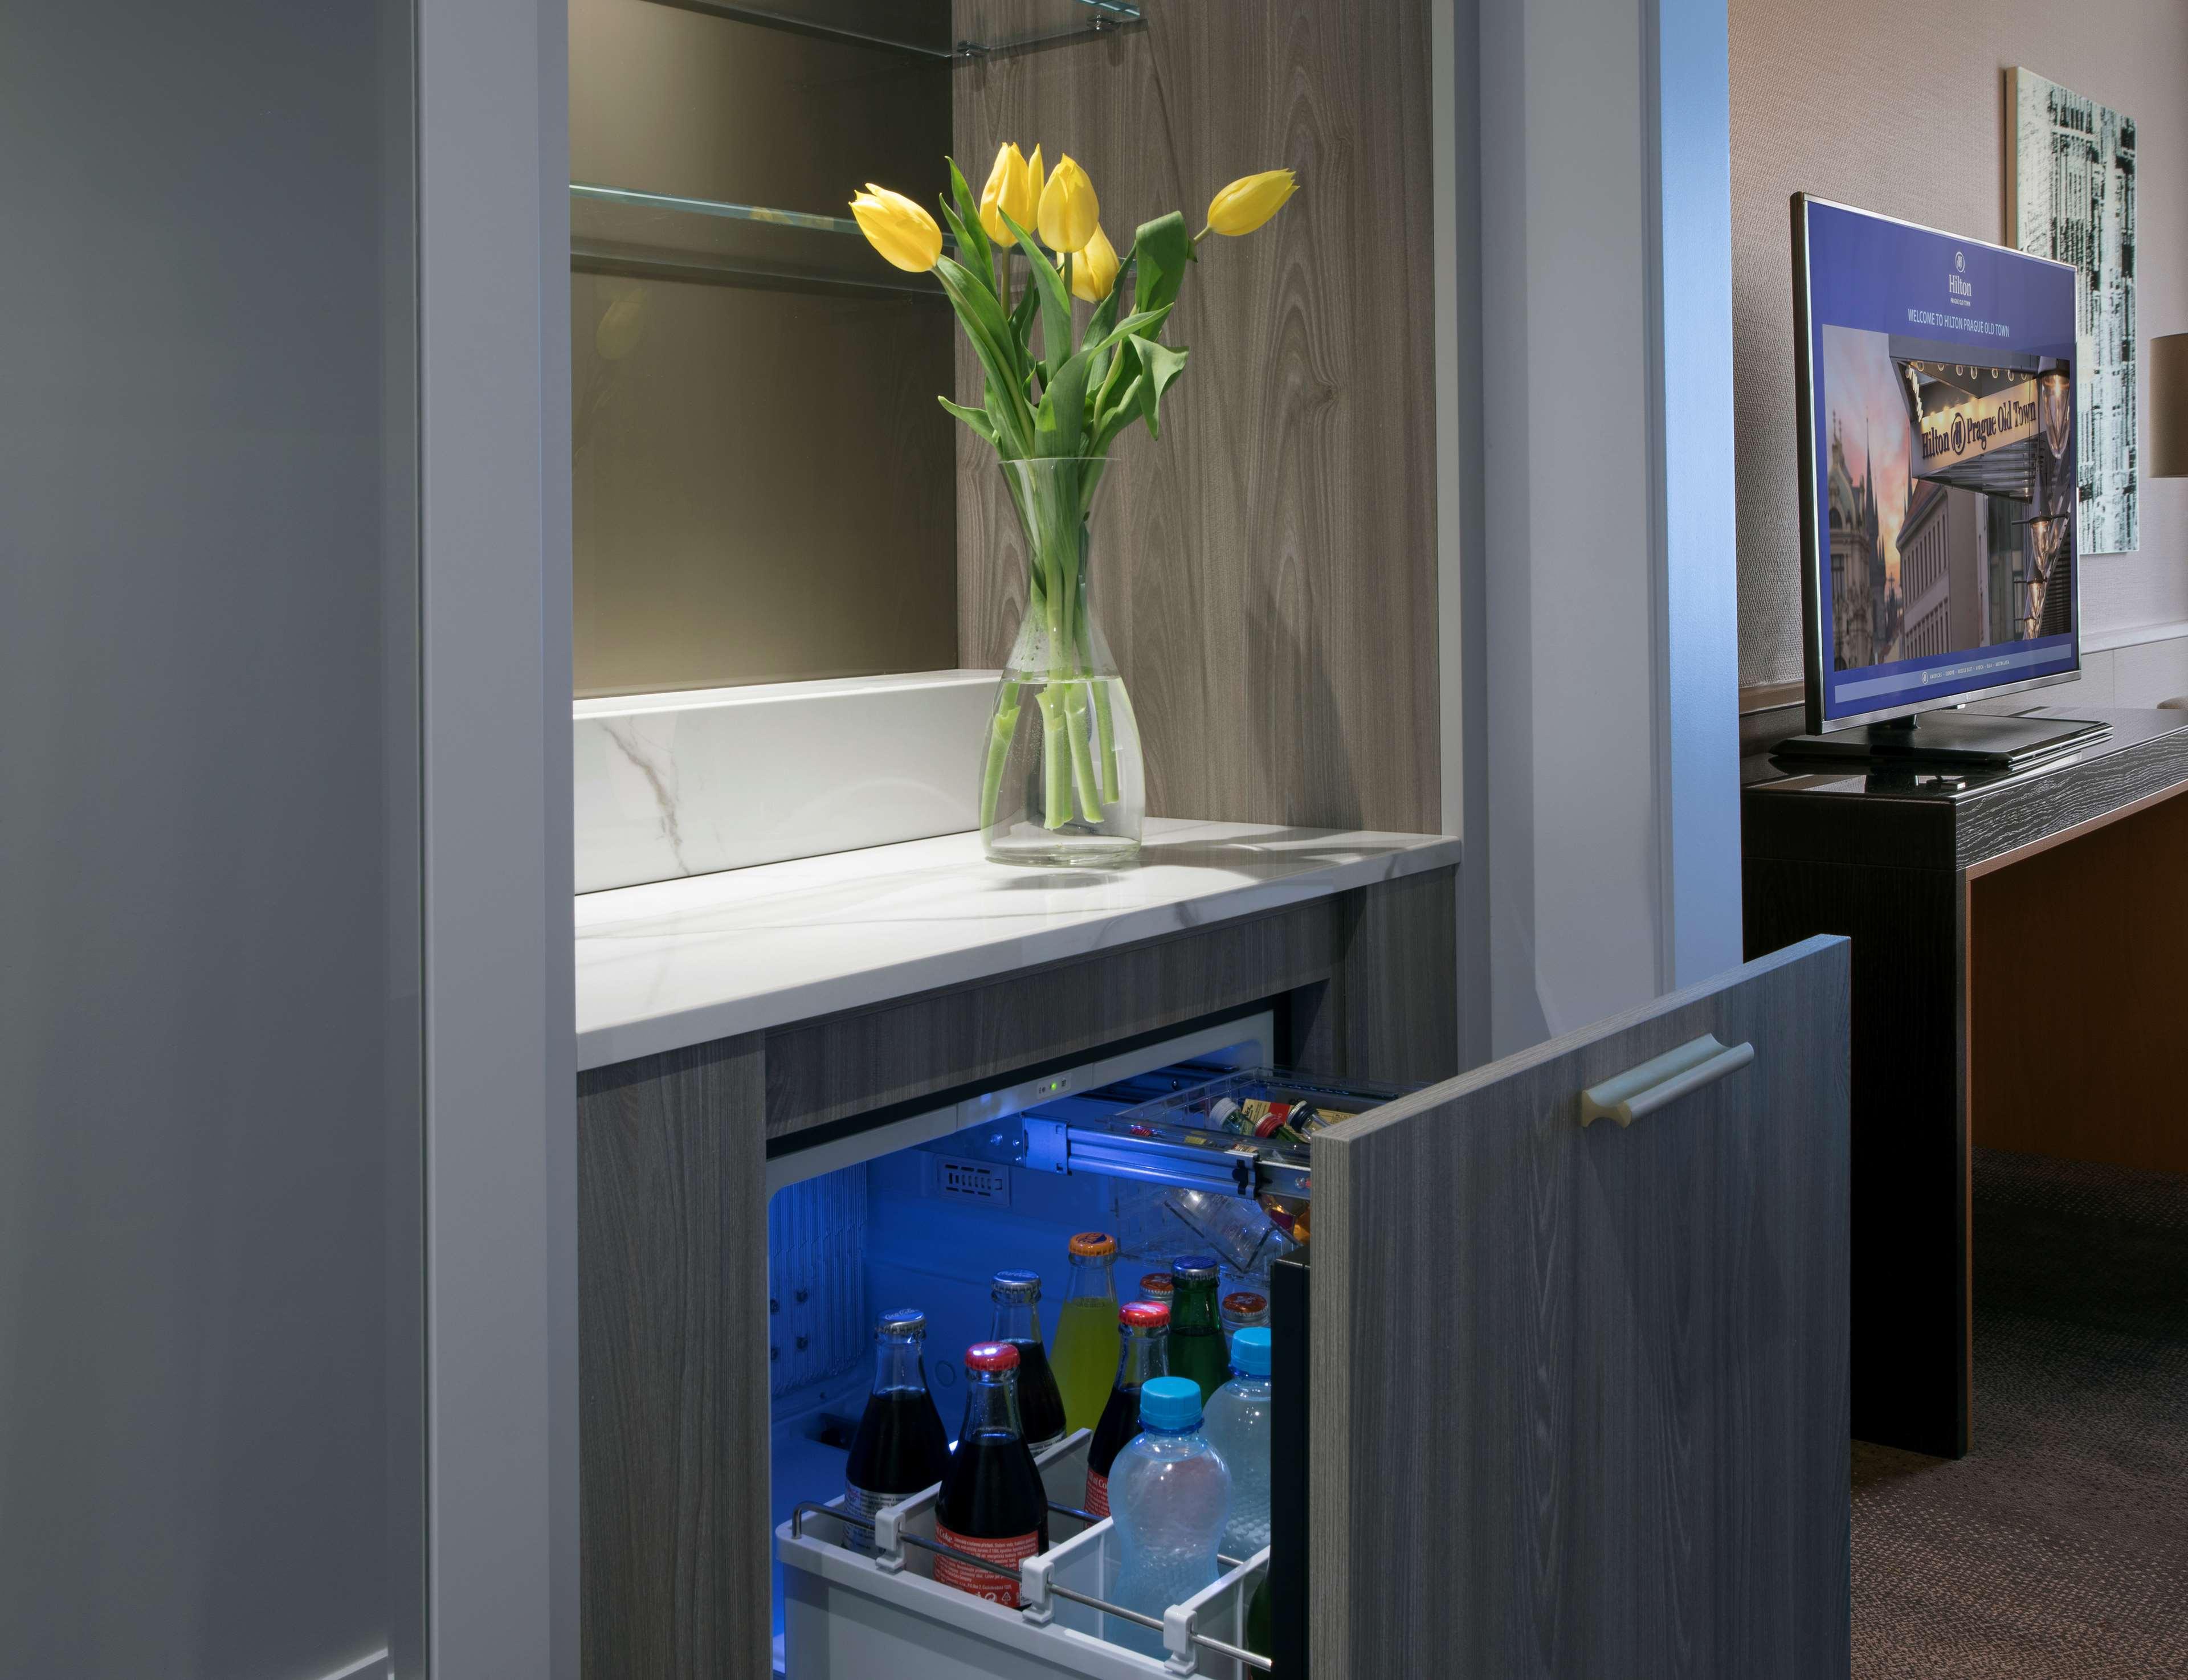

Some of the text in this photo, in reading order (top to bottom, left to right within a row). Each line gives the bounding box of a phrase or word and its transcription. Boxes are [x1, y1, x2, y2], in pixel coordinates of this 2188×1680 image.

[1949, 274, 1971, 296] Hilton
[1908, 308, 2010, 337] WELCOME TO HILTON PRAGUE OLD TOWN
[1921, 400, 2036, 459] Hilton Prague Old Town
